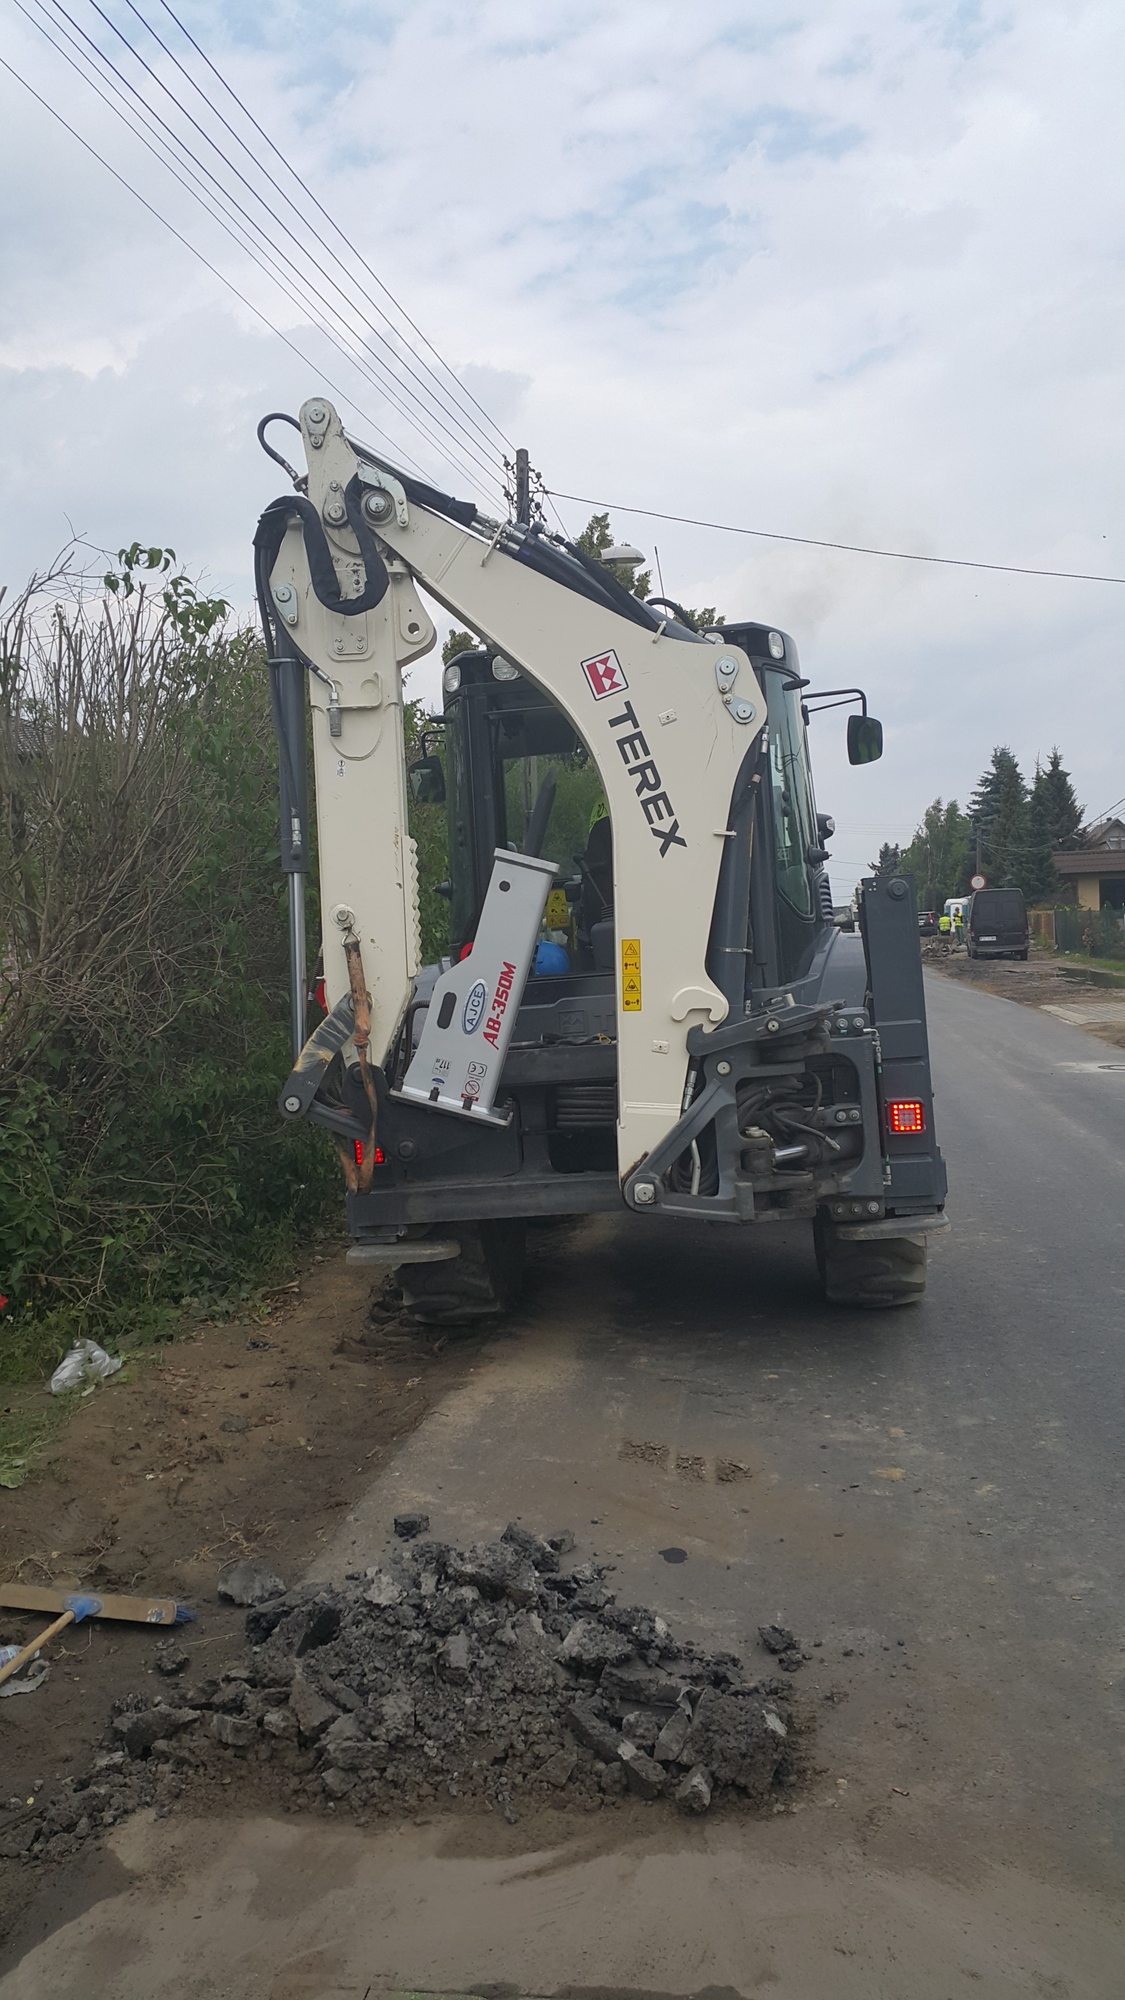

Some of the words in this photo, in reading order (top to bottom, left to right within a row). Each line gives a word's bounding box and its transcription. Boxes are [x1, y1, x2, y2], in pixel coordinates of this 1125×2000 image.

[608, 700, 688, 859] TEREX
[466, 990, 484, 1027] AJCE
[483, 961, 517, 1051] AB-350M
